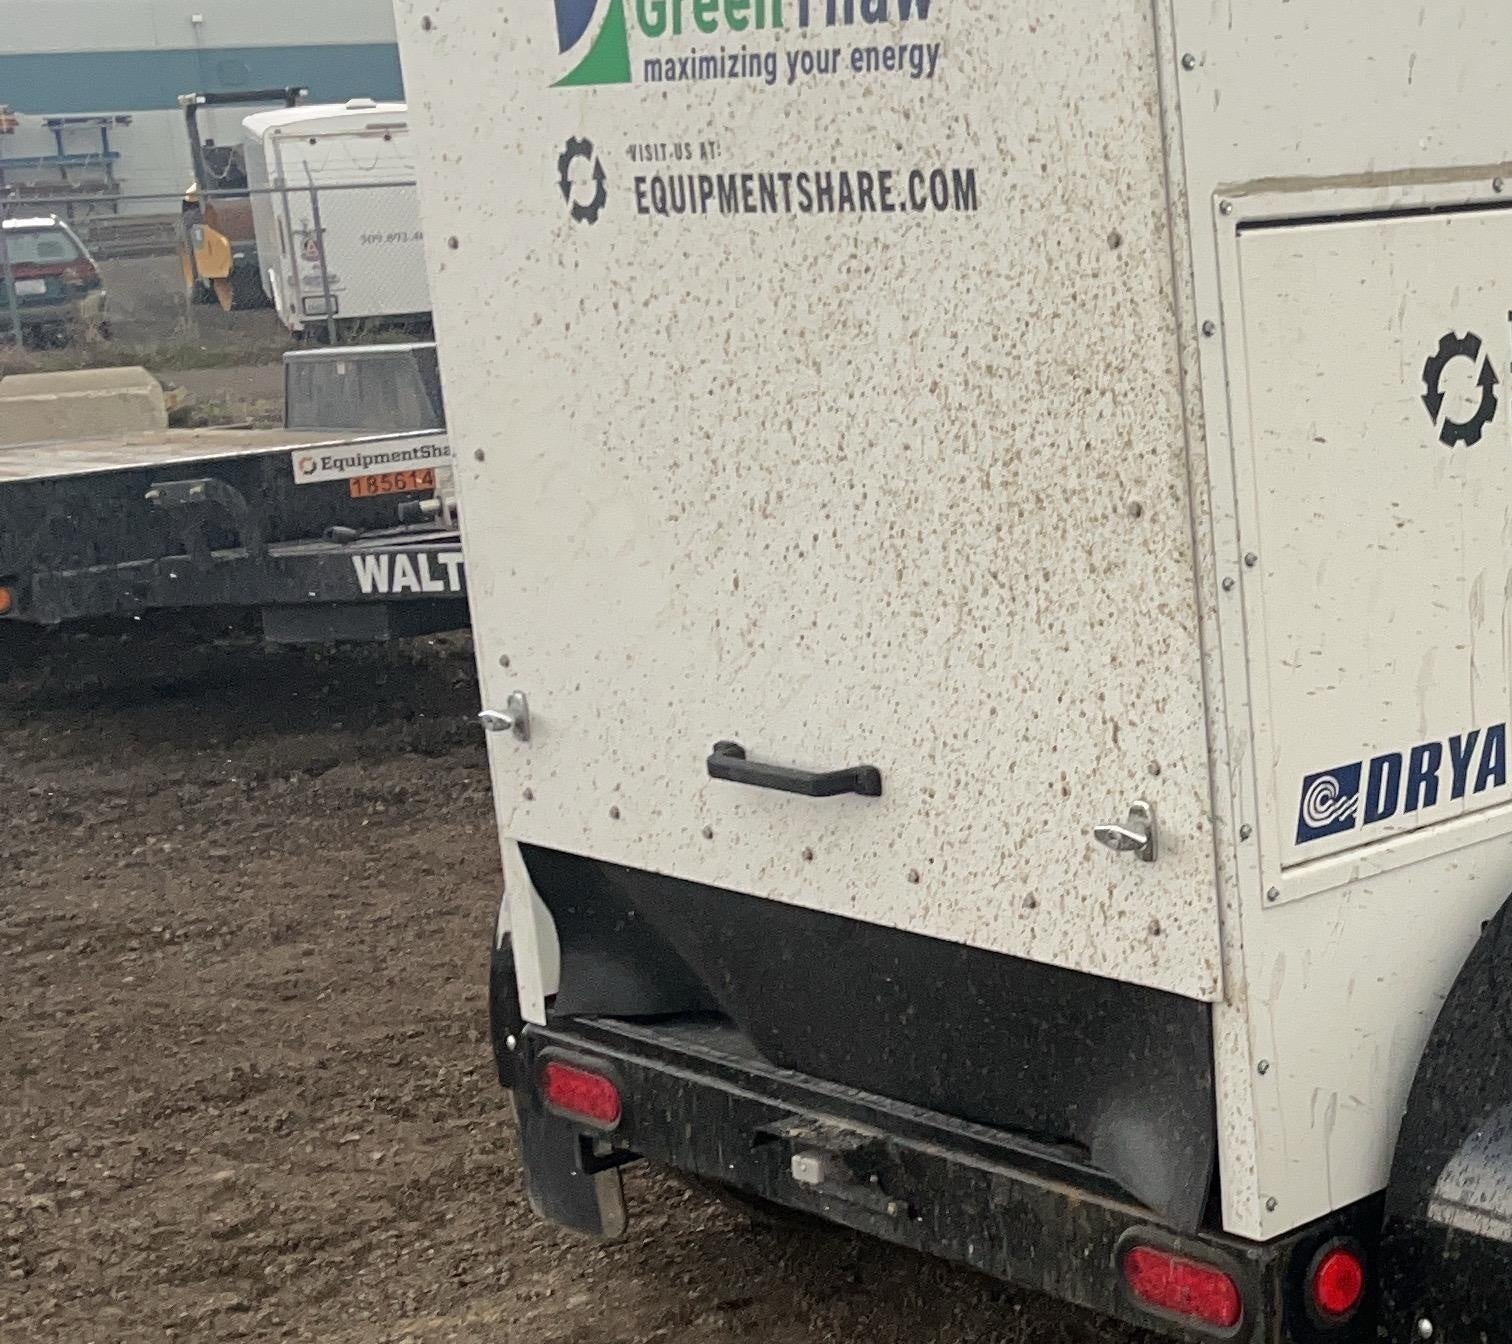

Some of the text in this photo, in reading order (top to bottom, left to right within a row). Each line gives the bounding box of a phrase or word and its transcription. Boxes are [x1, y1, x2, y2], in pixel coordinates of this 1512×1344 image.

[643, 41, 942, 86] maximizing your energy
[628, 143, 668, 163] VISIT
[673, 142, 693, 162] US
[633, 167, 979, 218] EQUIPMENTSHARE.COM
[351, 468, 434, 498] 185614
[352, 551, 465, 594] WALT
